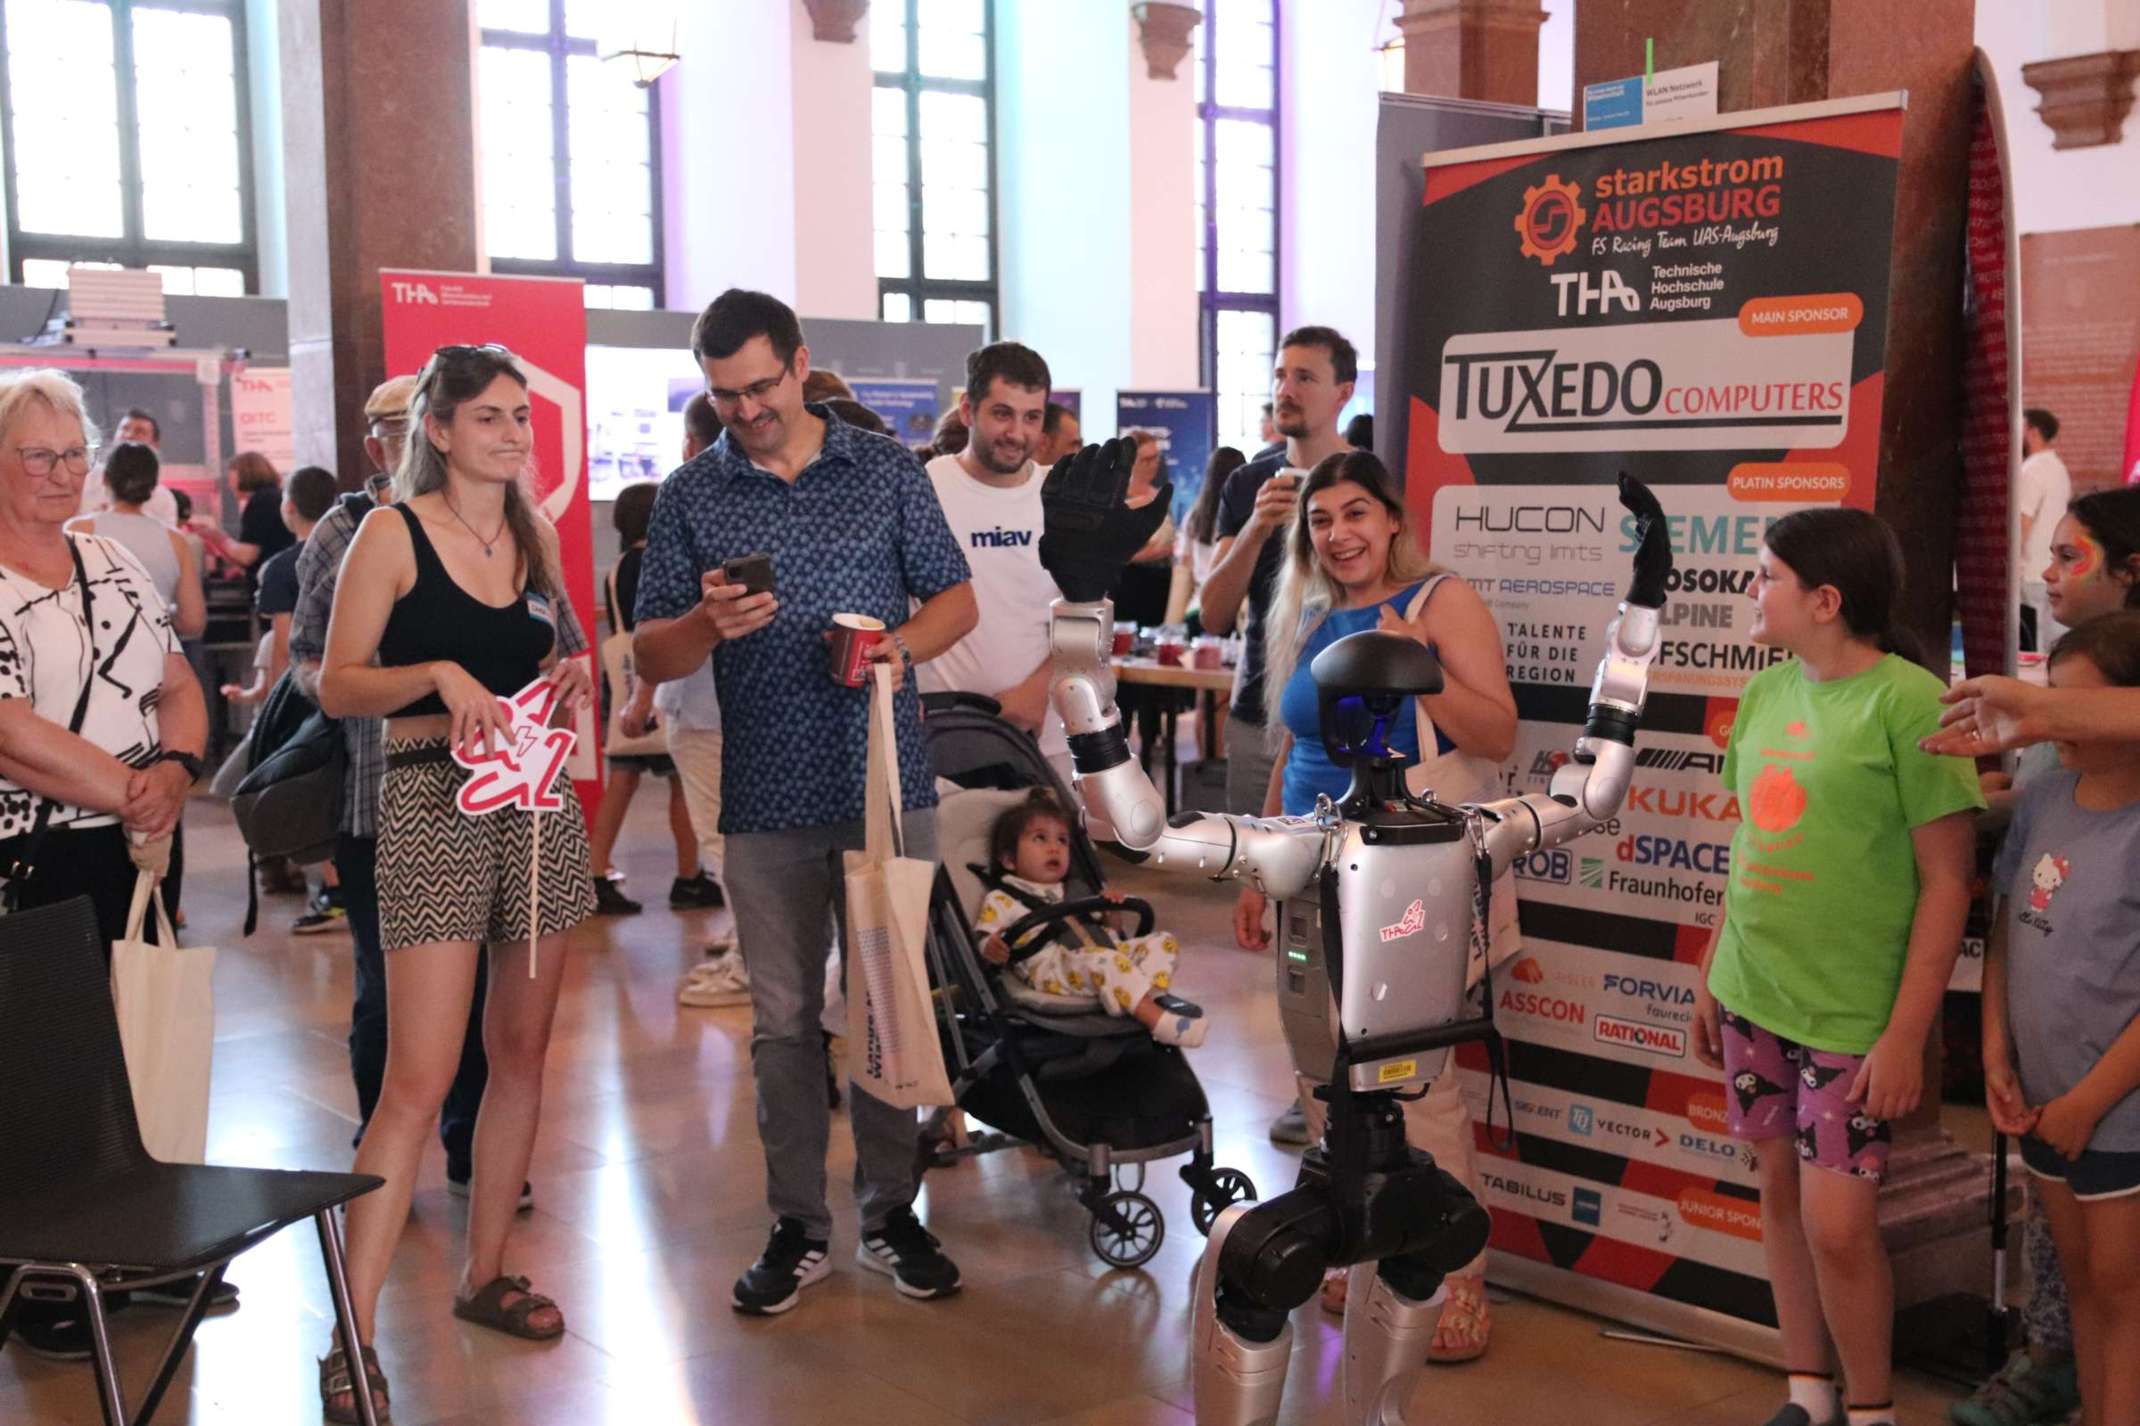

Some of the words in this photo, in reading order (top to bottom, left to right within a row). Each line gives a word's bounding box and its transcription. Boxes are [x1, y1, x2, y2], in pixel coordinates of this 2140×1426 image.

[1595, 155, 1784, 198] starkstrom
[1591, 184, 1781, 233] AUGSBURG
[1592, 237, 1607, 255] FS
[1612, 236, 1651, 258] Racing
[1657, 231, 1687, 249] Team
[1693, 221, 1779, 249] UAS-Augsburg
[1652, 262, 1722, 279] Technische
[391, 282, 439, 305] THA
[1551, 270, 1640, 316] THA
[1651, 278, 1724, 294] Hochschule
[1650, 296, 1711, 312] Augsburg
[1751, 310, 1785, 324] MAIN
[1788, 307, 1848, 322] SPONSOR
[1445, 349, 1663, 430] TUXEDO
[1664, 381, 1843, 415] COMPUTERS
[1733, 476, 1775, 489] PLATIN
[1777, 476, 1845, 490] SPONSORS
[1456, 506, 1605, 533] HUCON
[971, 526, 1032, 547] miav
[1618, 514, 1779, 554] SEME
[1500, 579, 1616, 596] AEROSPACE
[1665, 568, 1754, 594] OSOKA
[1659, 603, 1733, 629] LPINE
[1508, 623, 1587, 640] TALENTE
[1506, 642, 1540, 659] FÜR
[1549, 647, 1578, 662] DIE
[1507, 665, 1575, 682] REGION
[1628, 785, 1742, 822] KUKA
[1616, 835, 1730, 874] dSPACE
[1609, 871, 1724, 906] Fraunhofer
[1604, 974, 1695, 1005] FORVIA
[1501, 990, 1585, 1024] ASSCON
[1646, 1004, 1691, 1022] faureci
[1599, 1021, 1680, 1050] RATIONAL
[1689, 1104, 1728, 1123] BRONZ
[1597, 1119, 1651, 1140] VECTOR
[1680, 1134, 1735, 1157] DELO
[1481, 1173, 1566, 1207] TABILUS
[1680, 1201, 1724, 1220] JUNIOR
[1727, 1210, 1761, 1229] SPON
